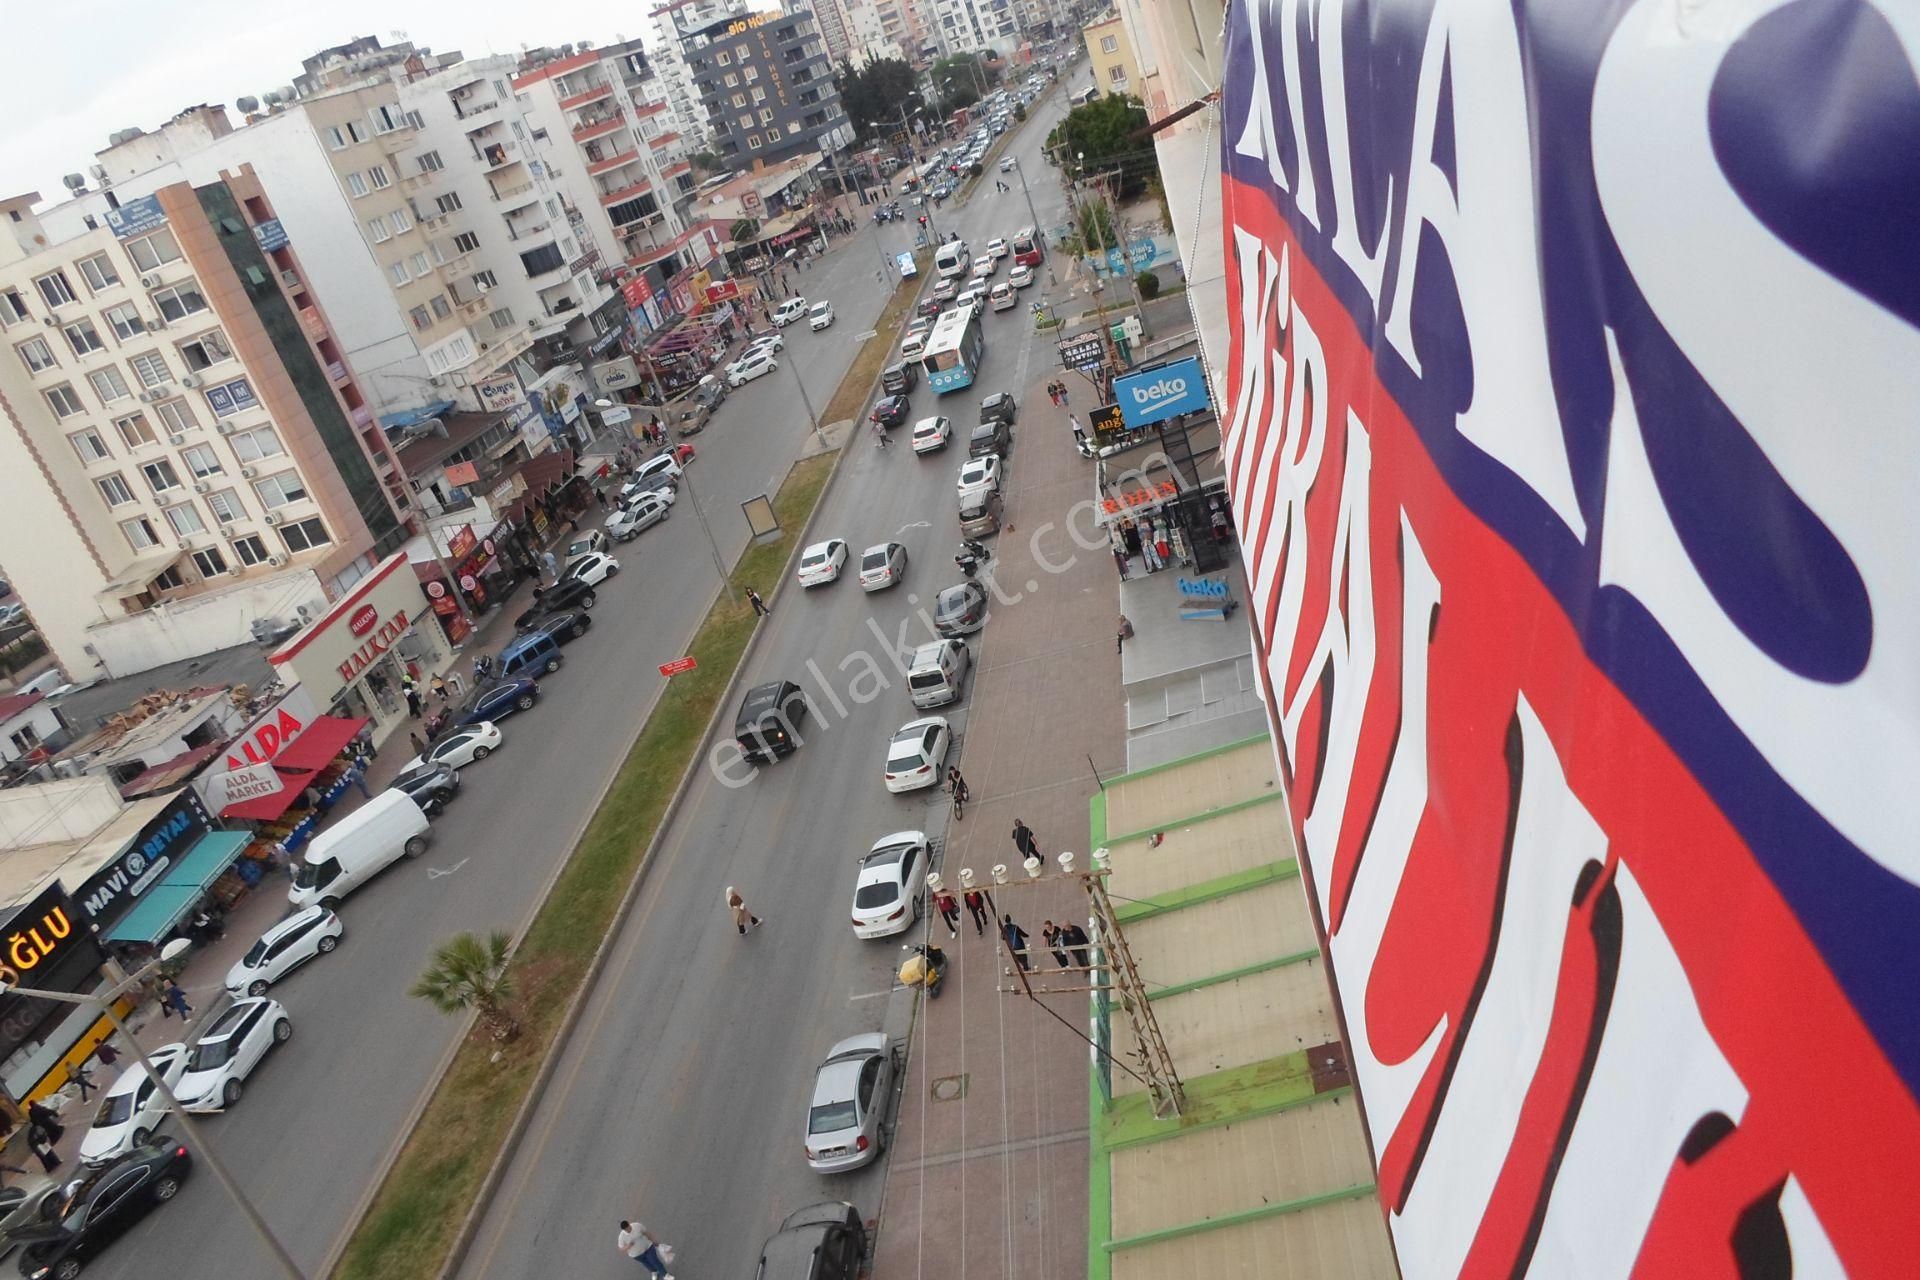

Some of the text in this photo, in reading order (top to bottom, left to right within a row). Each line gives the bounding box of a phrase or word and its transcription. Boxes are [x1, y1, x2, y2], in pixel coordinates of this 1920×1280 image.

[1126, 325, 1139, 333] TEB
[606, 372, 626, 385] platin
[1132, 377, 1187, 404] beko
[1177, 576, 1227, 598] beko
[335, 610, 411, 684] HALKTAN
[225, 772, 259, 789] ALDA
[225, 779, 275, 802] MARKET
[142, 810, 191, 861] BEYAZ
